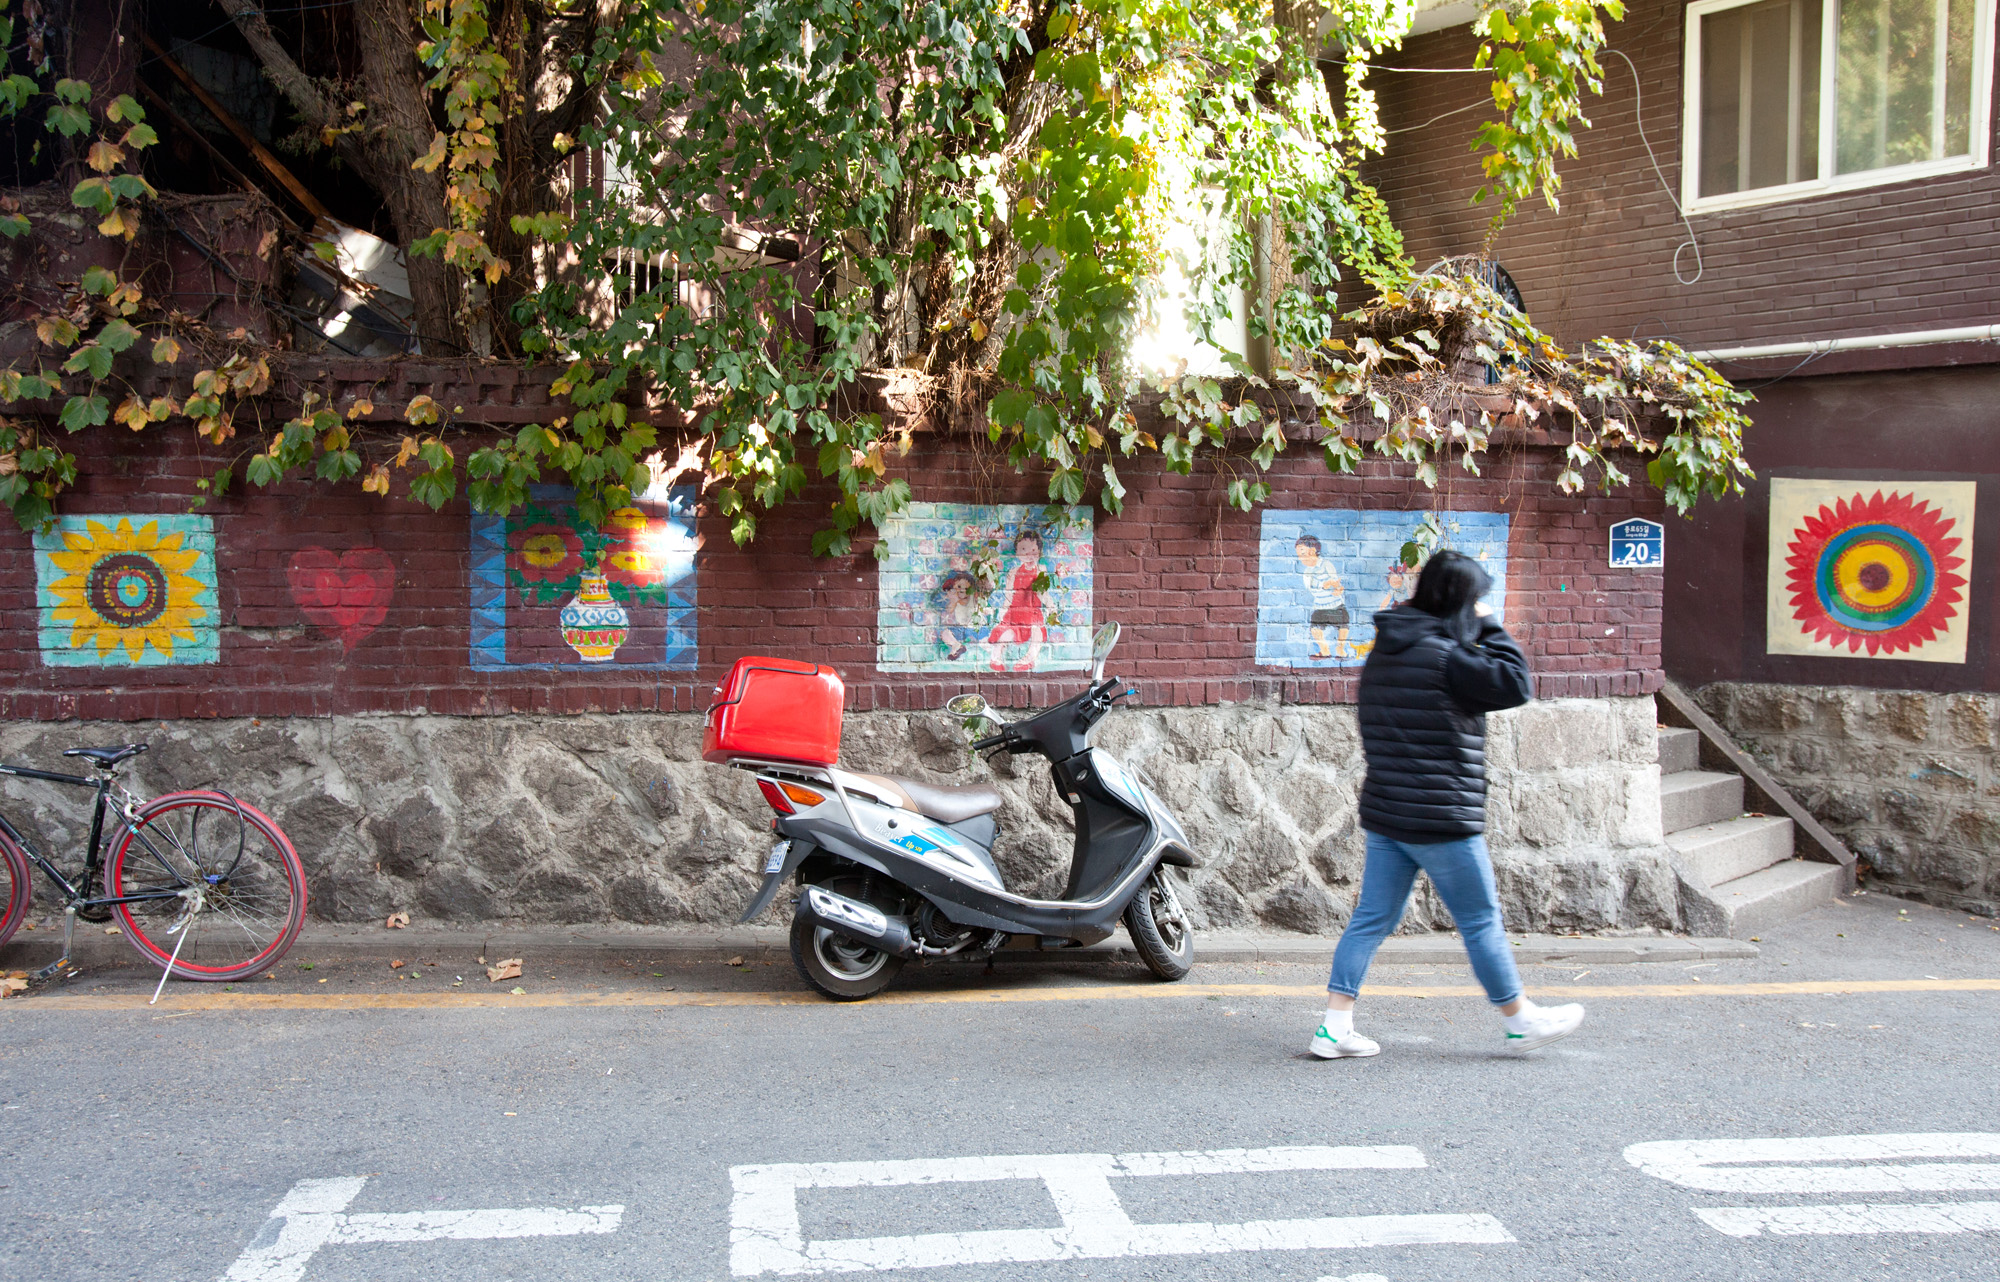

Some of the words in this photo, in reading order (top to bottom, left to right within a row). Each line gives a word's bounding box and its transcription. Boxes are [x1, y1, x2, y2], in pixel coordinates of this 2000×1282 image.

[1624, 542, 1649, 562] 20
[874, 823, 905, 844] Beaver
[905, 840, 915, 850] Up
